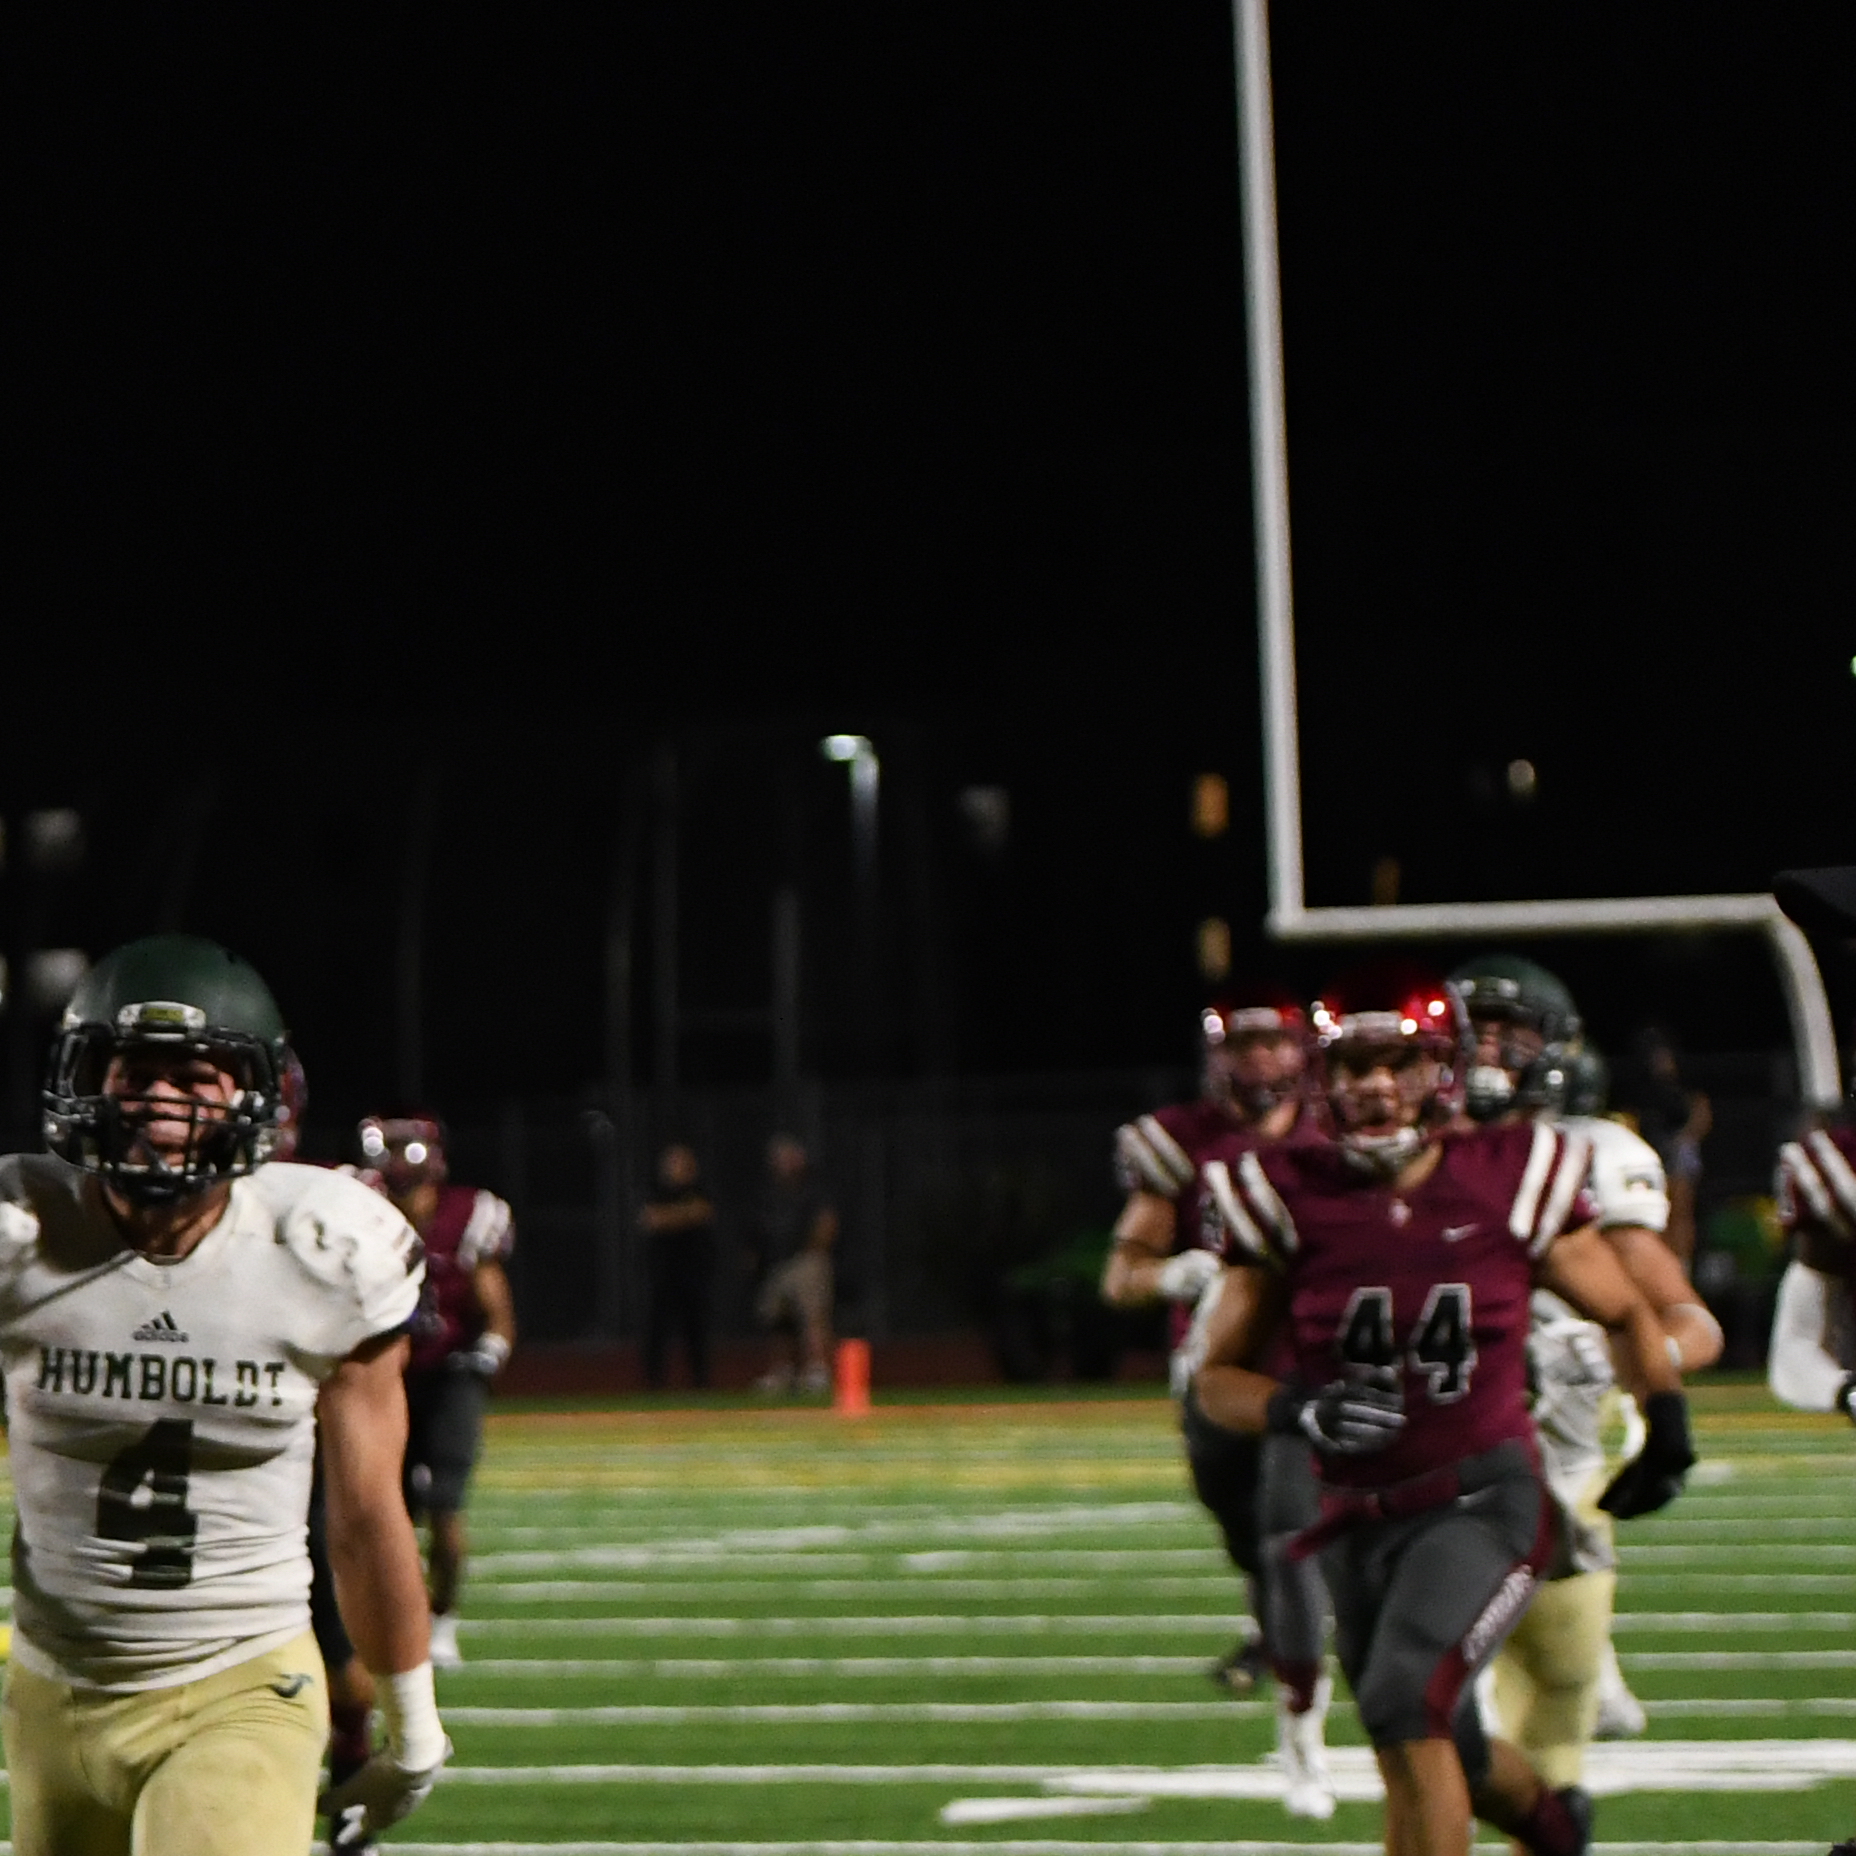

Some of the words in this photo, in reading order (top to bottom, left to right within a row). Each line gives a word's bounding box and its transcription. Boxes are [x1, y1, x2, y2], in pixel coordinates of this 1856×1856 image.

[37, 1347, 285, 1407] HUMBOLDT
[1334, 1283, 1478, 1405] 44
[97, 1417, 198, 1590] 4
